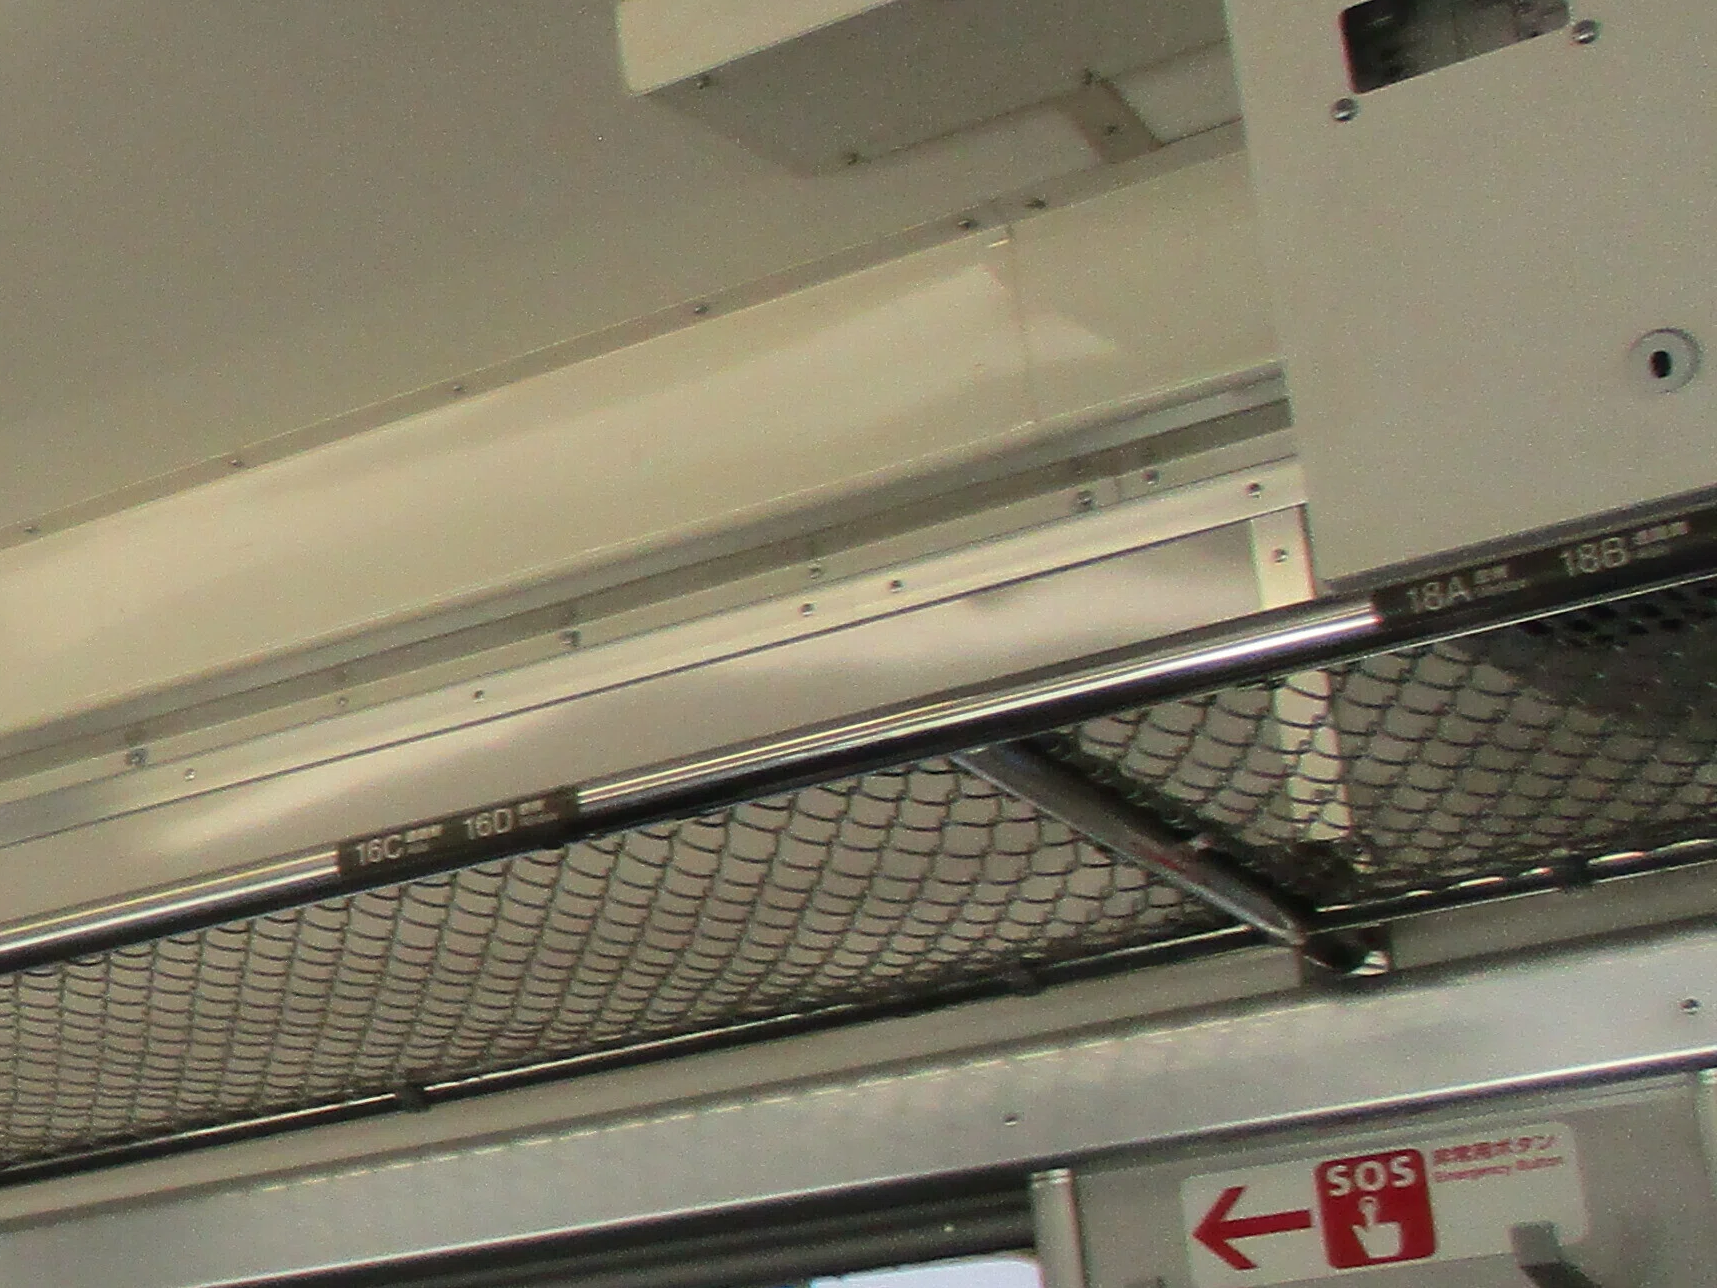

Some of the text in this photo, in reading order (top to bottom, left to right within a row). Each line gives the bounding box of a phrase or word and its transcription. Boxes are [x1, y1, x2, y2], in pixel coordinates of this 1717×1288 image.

[1406, 578, 1473, 614] 18A
[1558, 536, 1630, 577] 18B
[356, 835, 405, 867] 16C
[463, 807, 517, 841] 16D
[1327, 1155, 1417, 1197] SOS
